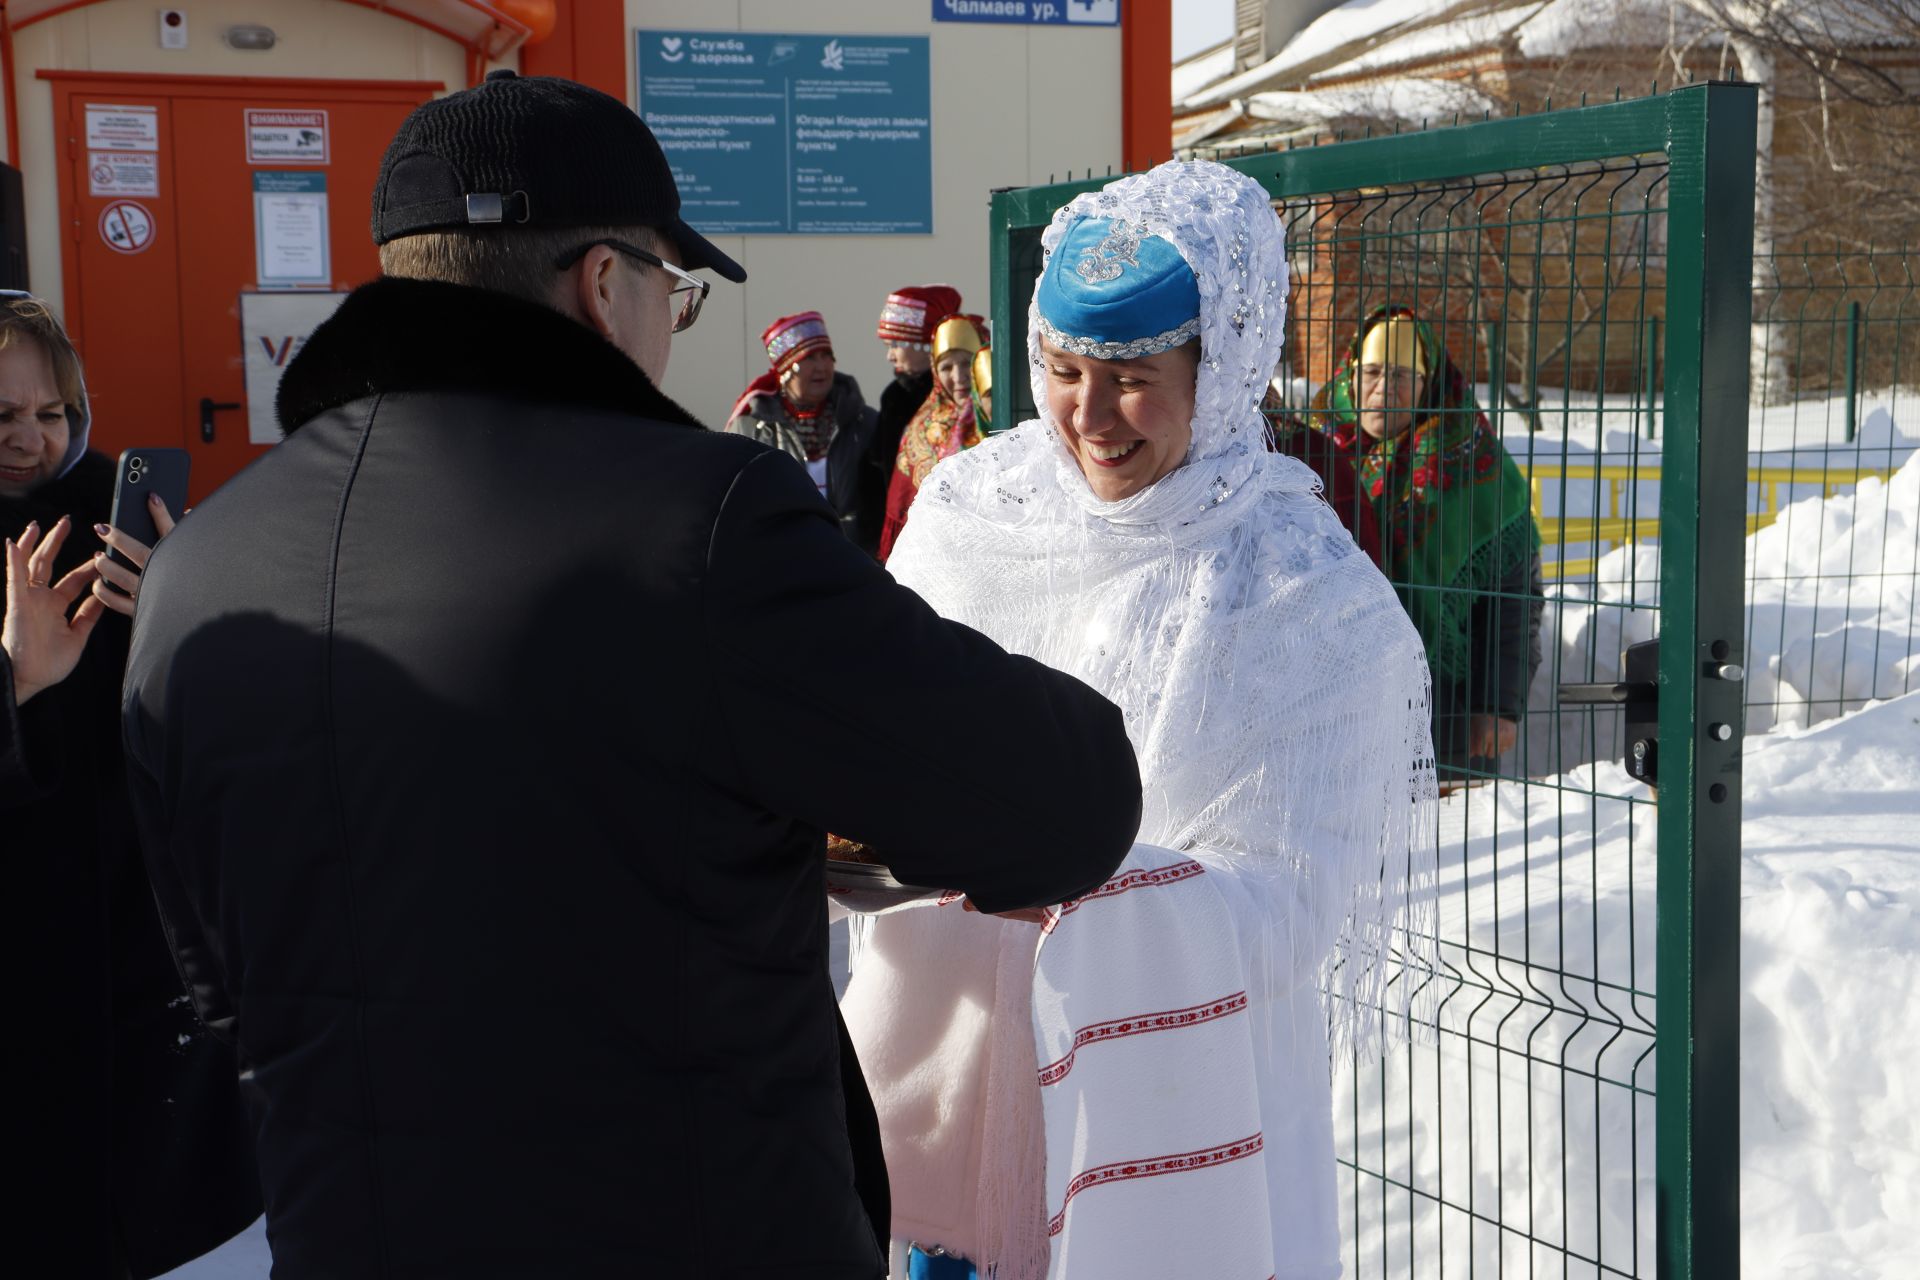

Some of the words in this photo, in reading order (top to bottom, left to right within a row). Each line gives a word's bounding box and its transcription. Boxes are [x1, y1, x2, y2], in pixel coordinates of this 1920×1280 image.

[1033, 3, 1060, 20] ур.
[689, 38, 745, 52] Служба
[691, 53, 755, 65] здоровья
[251, 112, 322, 126] ВНИМАНИЕ!
[646, 112, 776, 126] Верхнекондратинский
[796, 114, 836, 128] Югары
[836, 115, 891, 129] Кондрата
[892, 117, 929, 128] авылы
[718, 141, 752, 152] пункт
[796, 142, 838, 153] пункты
